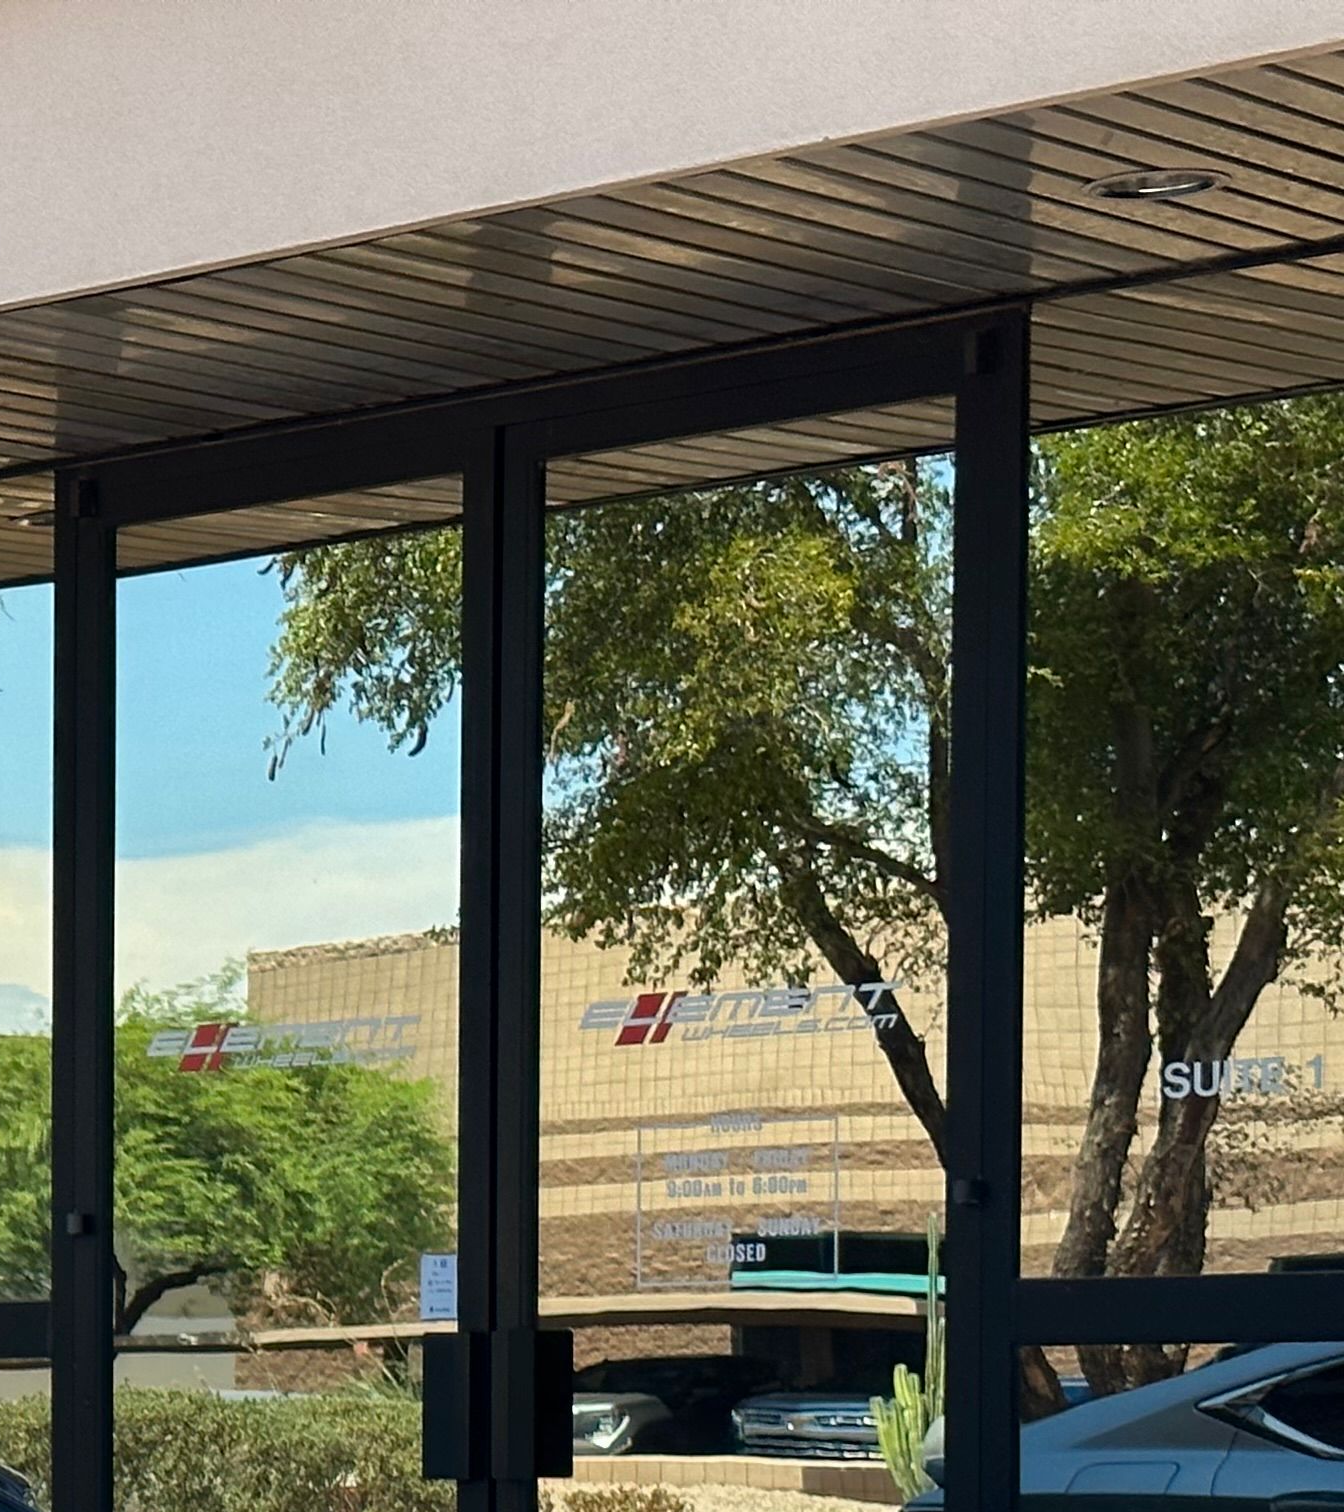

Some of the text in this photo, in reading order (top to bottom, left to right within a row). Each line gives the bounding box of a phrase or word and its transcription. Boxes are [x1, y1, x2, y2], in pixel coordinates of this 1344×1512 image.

[729, 1177, 745, 1196] to
[756, 1215, 822, 1238] SUNDAY
[707, 1243, 766, 1264] CLOSED
